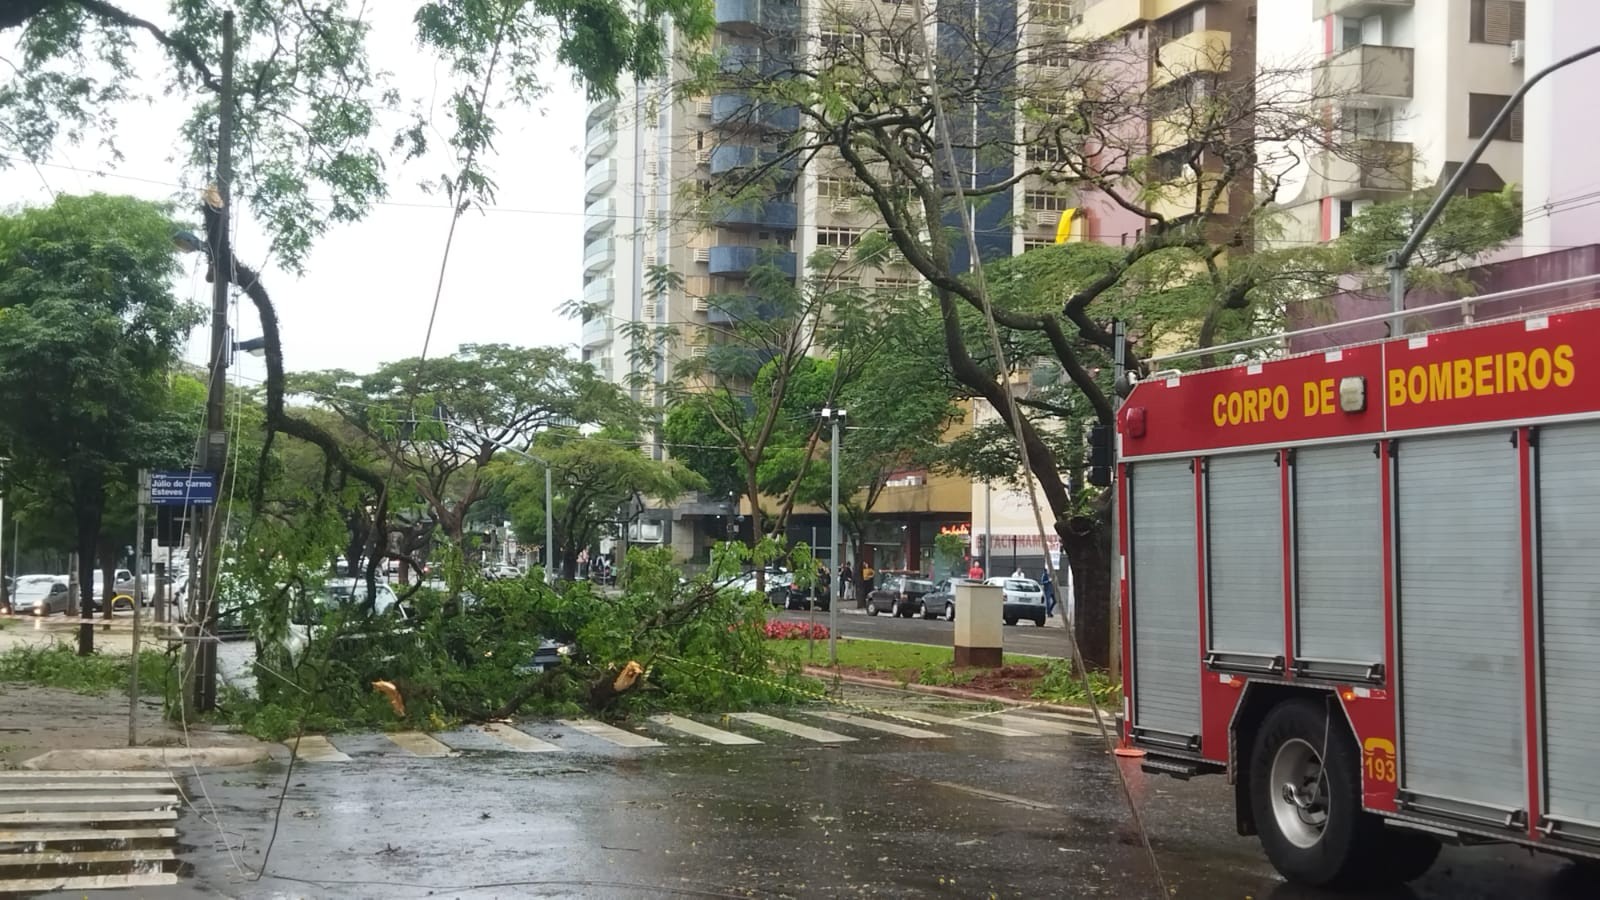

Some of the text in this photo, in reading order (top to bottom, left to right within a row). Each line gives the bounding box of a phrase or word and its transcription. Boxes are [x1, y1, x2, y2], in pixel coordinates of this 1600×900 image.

[1213, 344, 1575, 427] CORPO DE BOMBEIROS
[151, 488, 183, 496] Esteves
[173, 480, 184, 488] do
[185, 480, 212, 488] Carmo
[1366, 757, 1396, 783] 193
